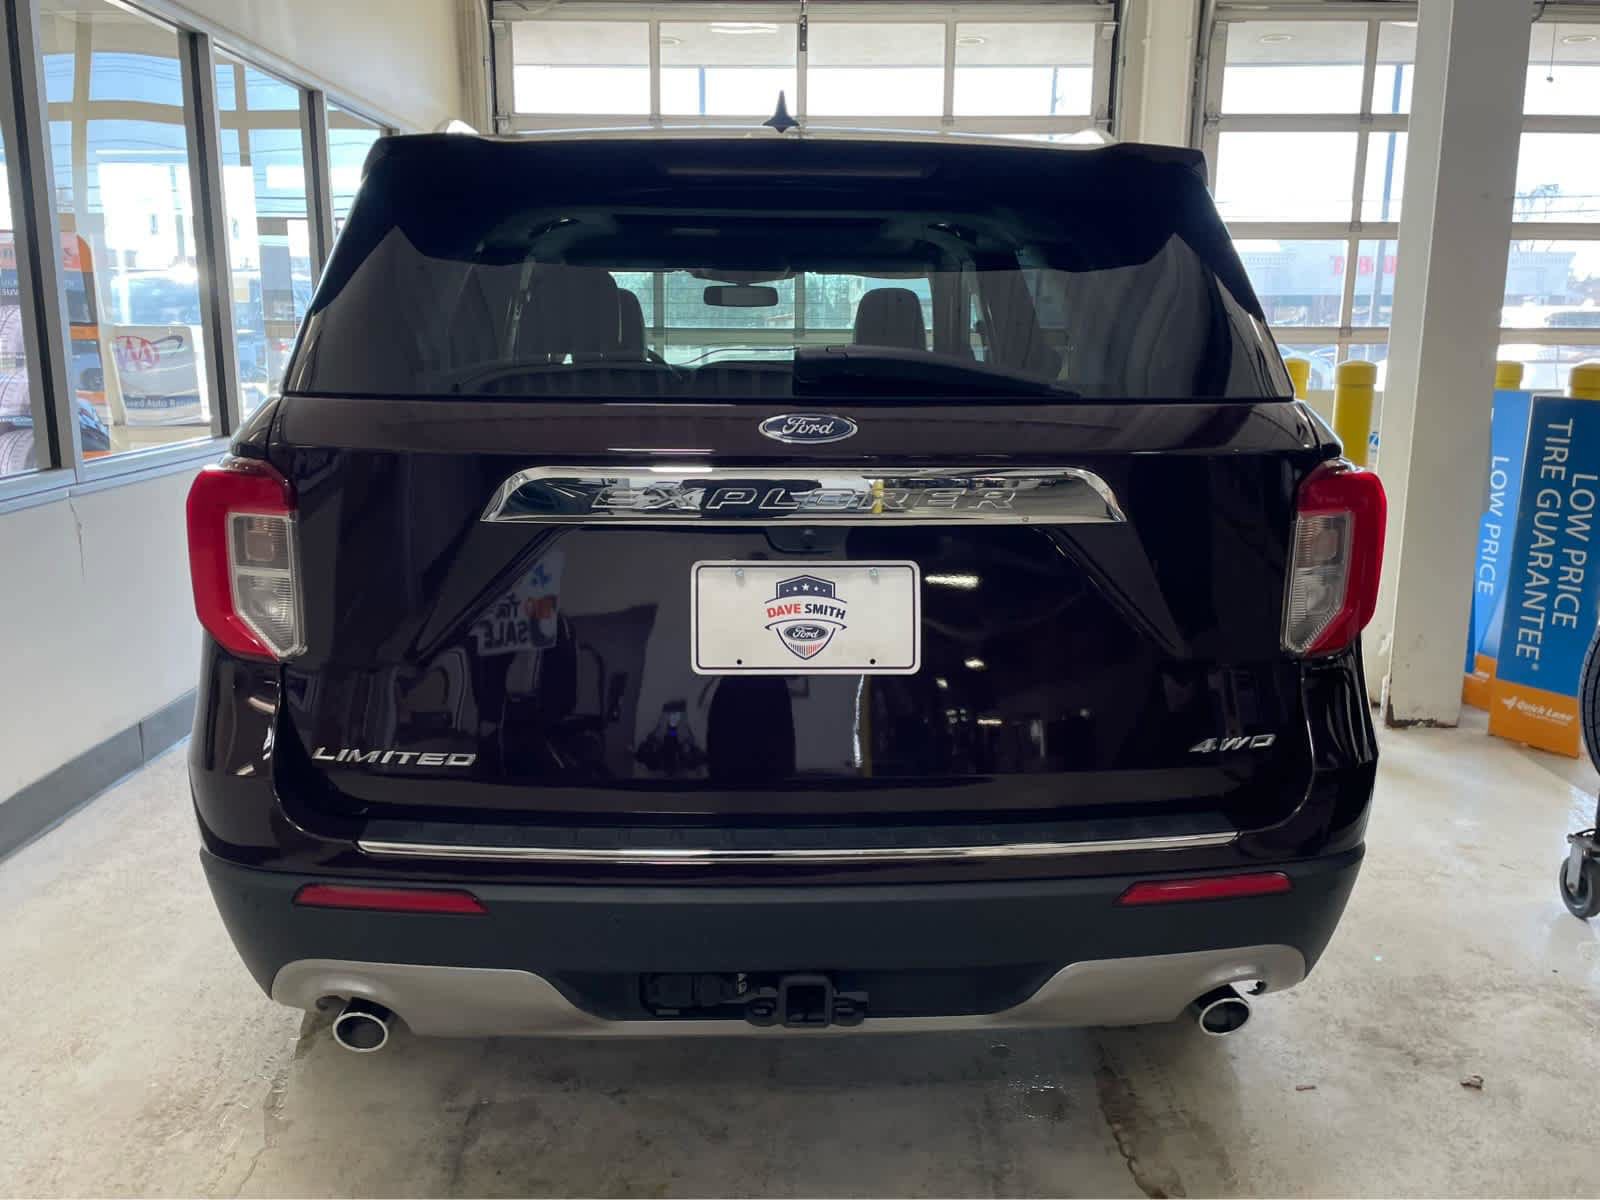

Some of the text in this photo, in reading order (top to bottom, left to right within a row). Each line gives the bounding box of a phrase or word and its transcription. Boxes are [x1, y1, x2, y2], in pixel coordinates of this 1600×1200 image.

[782, 416, 834, 434] Ford
[1540, 418, 1573, 480] TIRE
[592, 487, 1015, 511] EXPLORER
[1478, 456, 1510, 596] LOW PRICE
[1551, 473, 1599, 629] LOW PRICE
[767, 603, 847, 620] DAVE SMITH
[792, 625, 820, 639] Ford
[1516, 700, 1545, 715] Quick
[1545, 707, 1575, 721] Lane
[1188, 733, 1276, 752] 4WD
[311, 746, 477, 766] LIMITED
